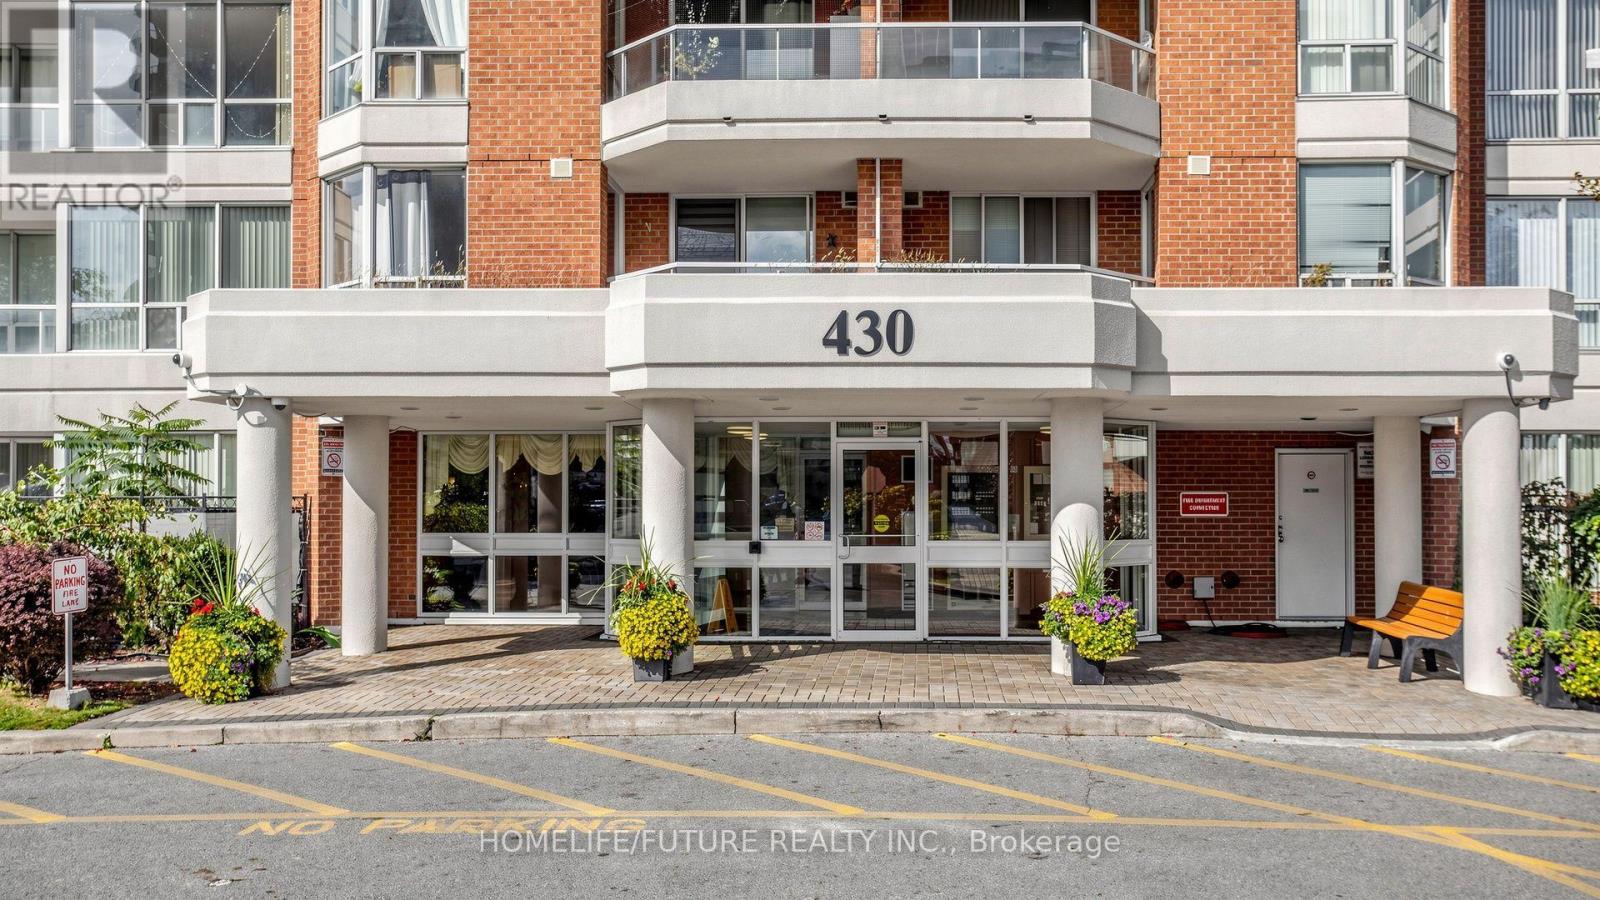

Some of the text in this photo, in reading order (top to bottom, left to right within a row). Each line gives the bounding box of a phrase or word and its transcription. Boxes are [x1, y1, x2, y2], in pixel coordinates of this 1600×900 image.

[822, 309, 915, 356] 430
[64, 564, 77, 575] NO
[55, 575, 86, 590] PARKING
[62, 589, 80, 598] FIRE
[61, 598, 80, 608] LANE
[237, 819, 647, 836] NO PARKING
